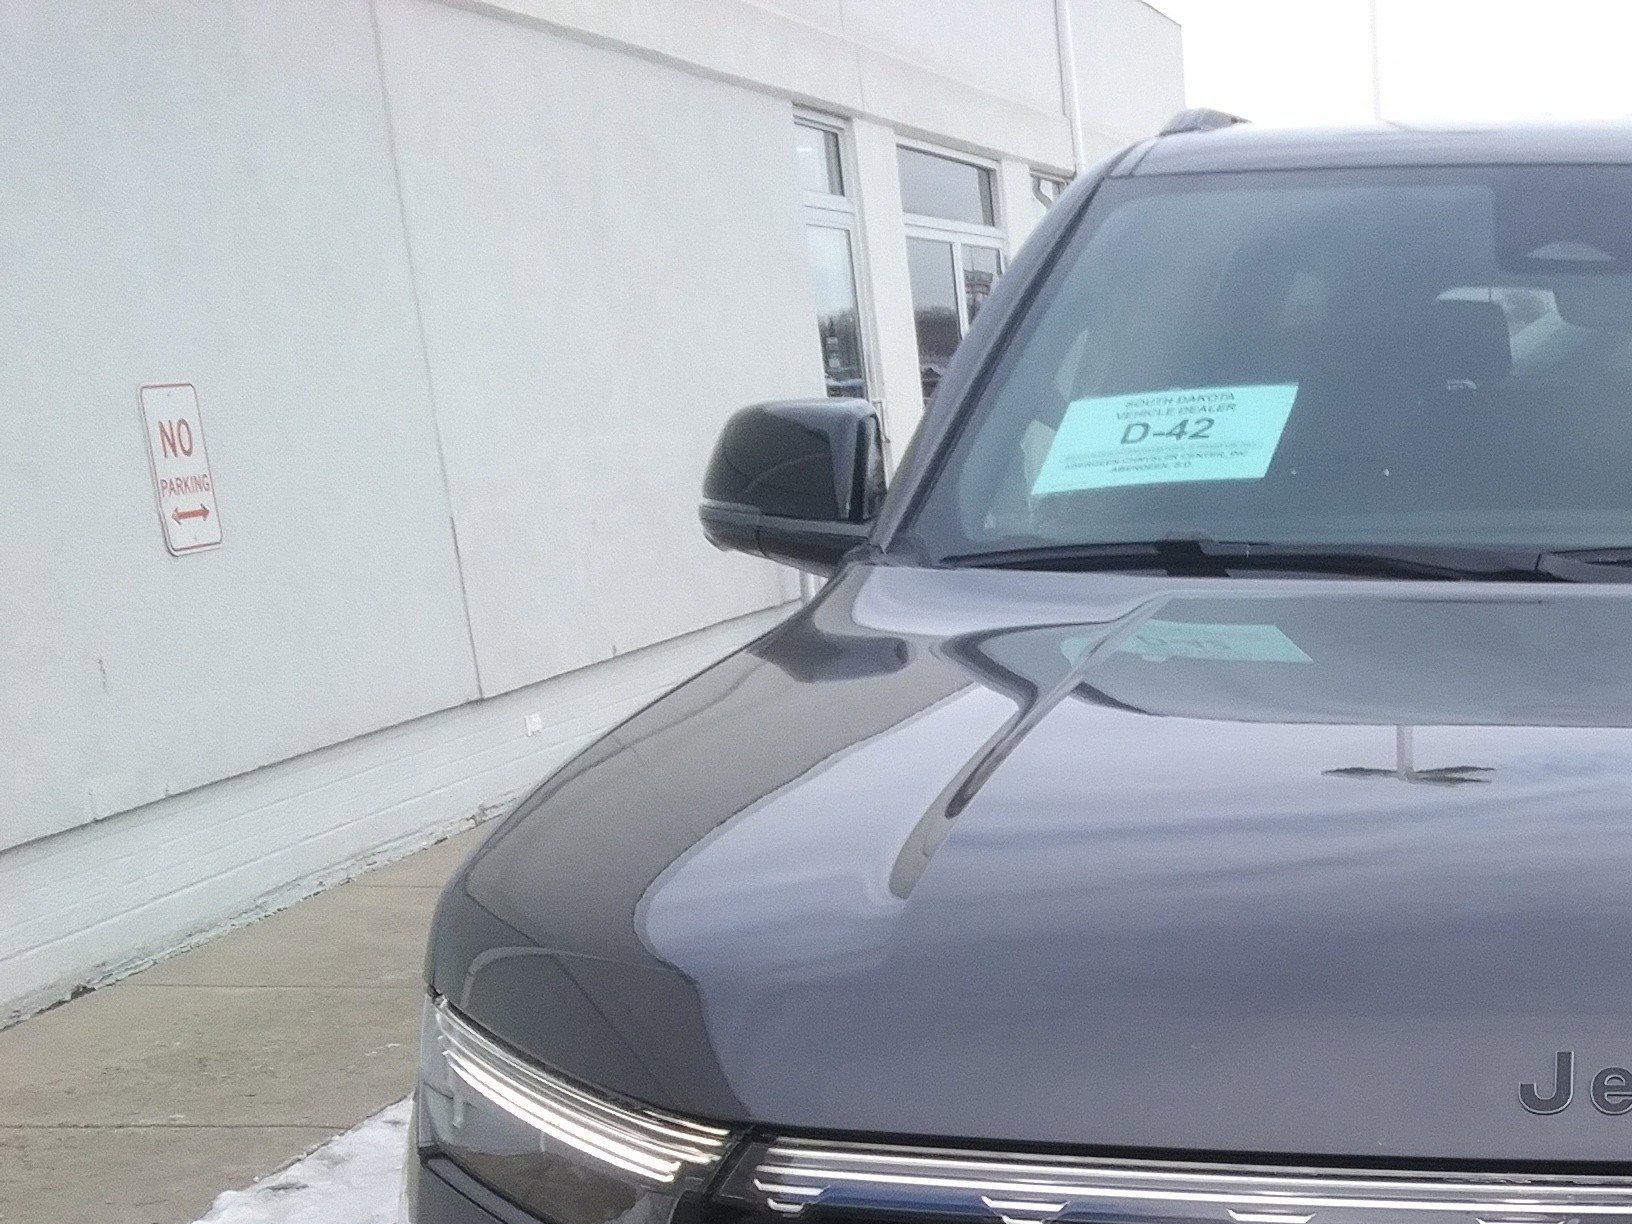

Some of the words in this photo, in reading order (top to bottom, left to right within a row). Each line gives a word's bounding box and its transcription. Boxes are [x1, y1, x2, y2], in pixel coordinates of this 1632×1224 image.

[1177, 391, 1236, 404] DAKOTA
[1178, 403, 1237, 414] DEALER
[158, 418, 193, 458] NO
[1120, 417, 1215, 445] D-42
[160, 473, 211, 498] PARKING
